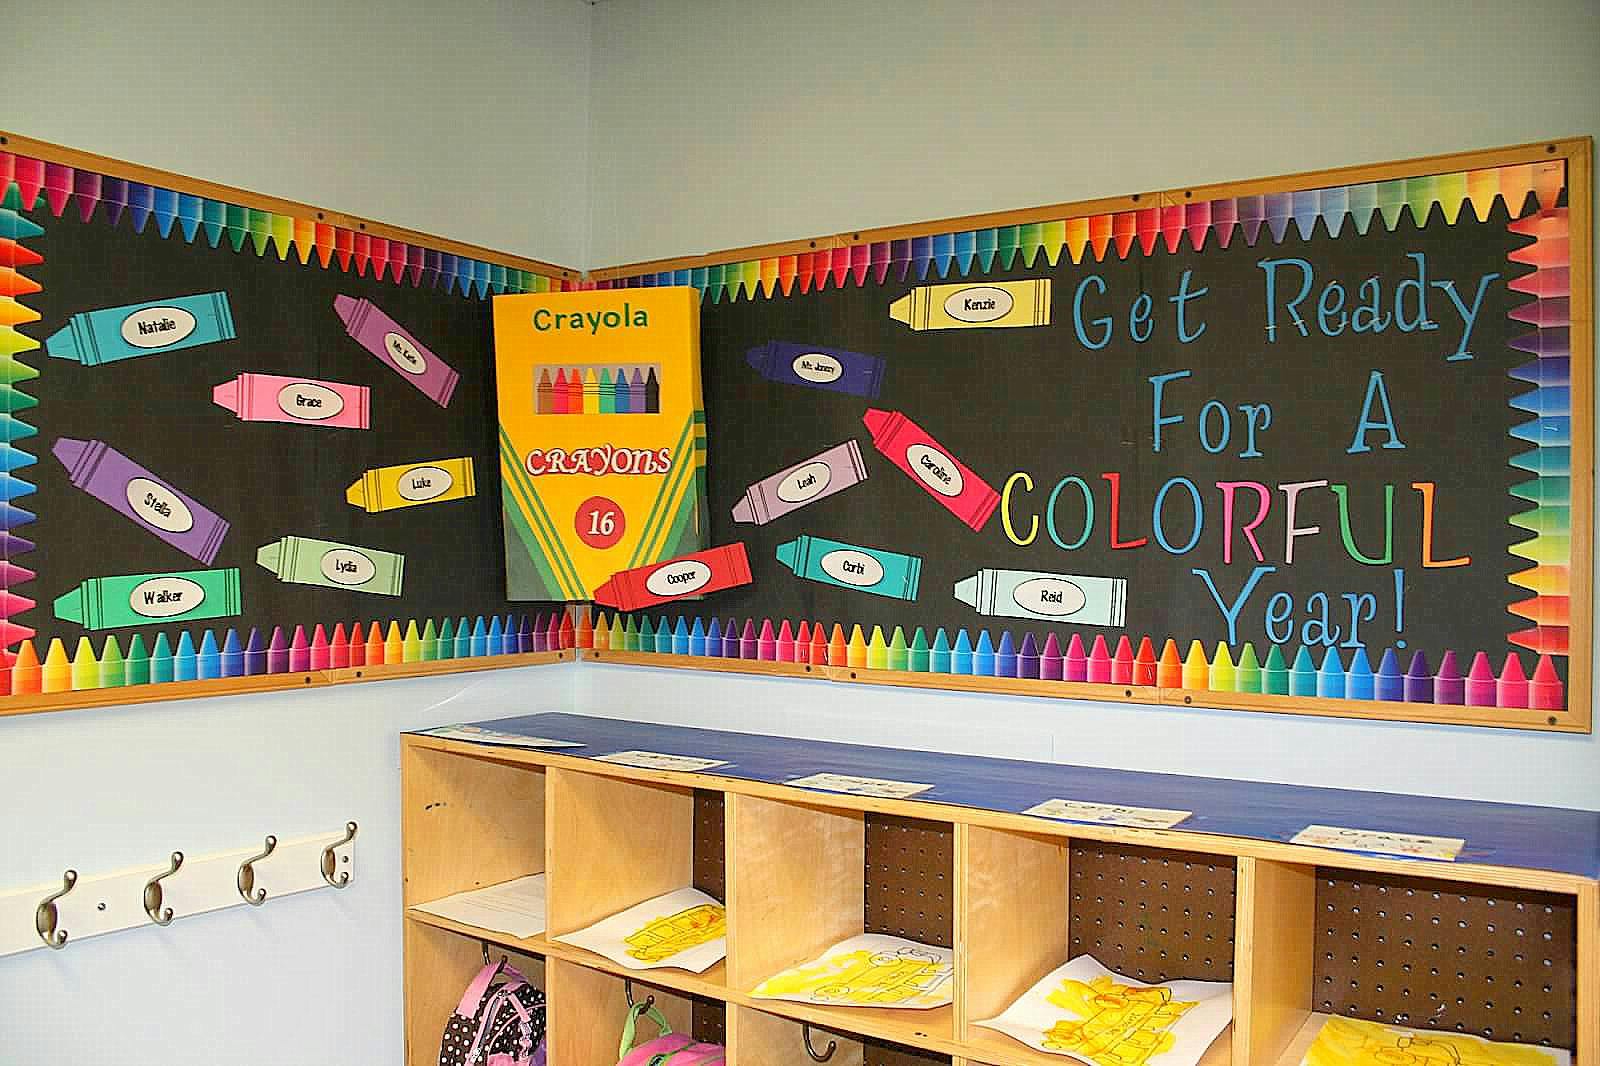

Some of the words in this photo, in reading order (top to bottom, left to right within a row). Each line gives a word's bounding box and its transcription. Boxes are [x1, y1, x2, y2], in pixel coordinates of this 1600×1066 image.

[964, 297, 996, 311] Kenzie
[1072, 269, 1209, 350] Get
[1257, 252, 1501, 361] Ready
[137, 317, 177, 335] Natalie
[533, 303, 649, 335] Crayola
[296, 393, 322, 408] Grace
[1148, 370, 1273, 459] For
[1345, 369, 1406, 454] A
[920, 454, 952, 485] Caroline
[411, 477, 432, 490] Luke
[796, 473, 817, 490] Leah
[144, 492, 171, 518] Stella
[587, 510, 616, 536] 16
[1000, 471, 1472, 568] COLORFUL
[335, 559, 357, 573] Lydia
[842, 559, 866, 575] Corbi
[667, 571, 696, 585] Cooper
[143, 589, 183, 605] Walker
[1040, 589, 1063, 604] Reid
[1191, 566, 1408, 649] Year!
